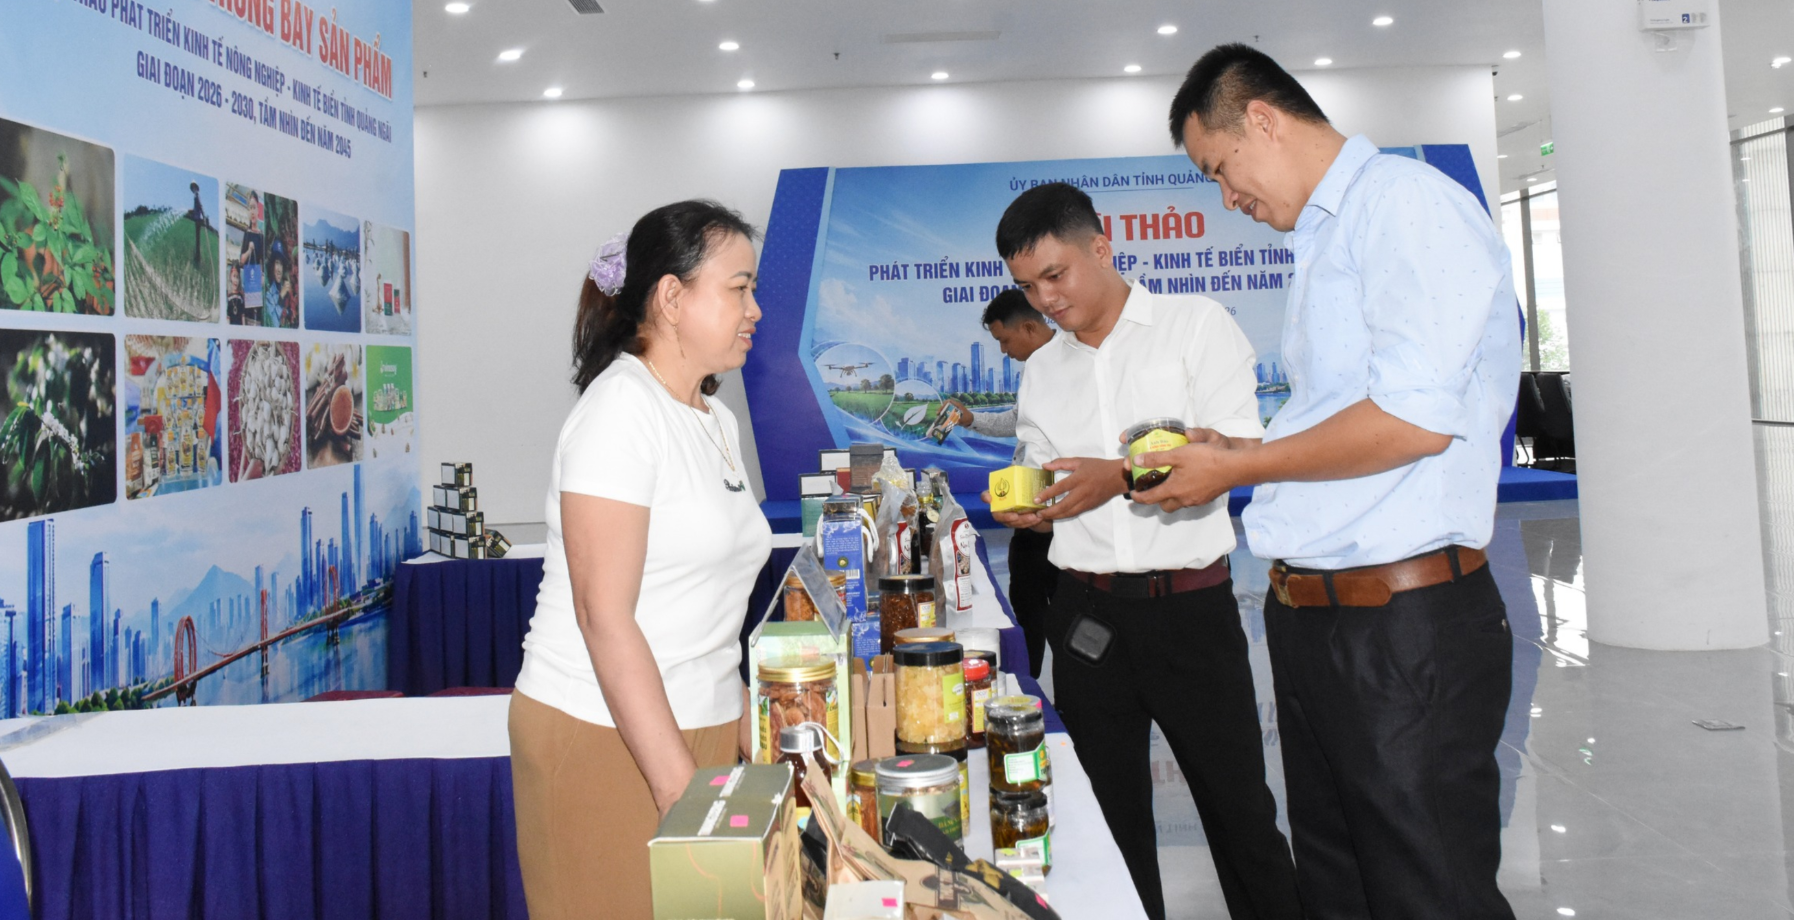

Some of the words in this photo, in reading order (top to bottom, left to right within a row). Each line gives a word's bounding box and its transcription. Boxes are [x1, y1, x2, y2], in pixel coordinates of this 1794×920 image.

[147, 8, 180, 48] TRIỂN
[184, 25, 209, 61] KINH
[211, 36, 223, 67] TẾ
[226, 45, 252, 80] NÔNG
[254, 66, 285, 97] NGHIỆP
[293, 78, 311, 107] KINH
[313, 85, 321, 112] TẾ
[323, 90, 339, 120] BIỂN
[356, 107, 377, 137] QUẢNG
[319, 8, 350, 76] SẢN
[354, 34, 392, 99] PHẨM
[137, 50, 161, 85] GIAI
[164, 61, 195, 100] ĐOẠN
[197, 76, 222, 109] 2026
[231, 90, 257, 125] 2030,
[258, 96, 277, 130] TẦM
[279, 109, 299, 138] NHÌN
[300, 115, 316, 145] ĐẾN
[317, 125, 334, 152] NĂM
[335, 134, 352, 159] 2045
[1010, 177, 1027, 191] ỦY
[1102, 173, 1130, 188] DÂN
[1135, 171, 1165, 186] TỈNH
[1119, 205, 1205, 241] THẢO
[869, 261, 909, 281] PHÁT
[914, 255, 960, 280] TRIỂN
[965, 260, 1003, 278] KINH
[1153, 252, 1191, 270] KINH
[1195, 245, 1214, 268] TẾ
[1218, 243, 1255, 267] BIỂN
[1259, 243, 1295, 265] TỈNH
[942, 286, 974, 304] GIAI
[1167, 273, 1206, 294] NHÌN
[1211, 270, 1242, 292] ĐẾN
[1247, 270, 1283, 291] NĂM
